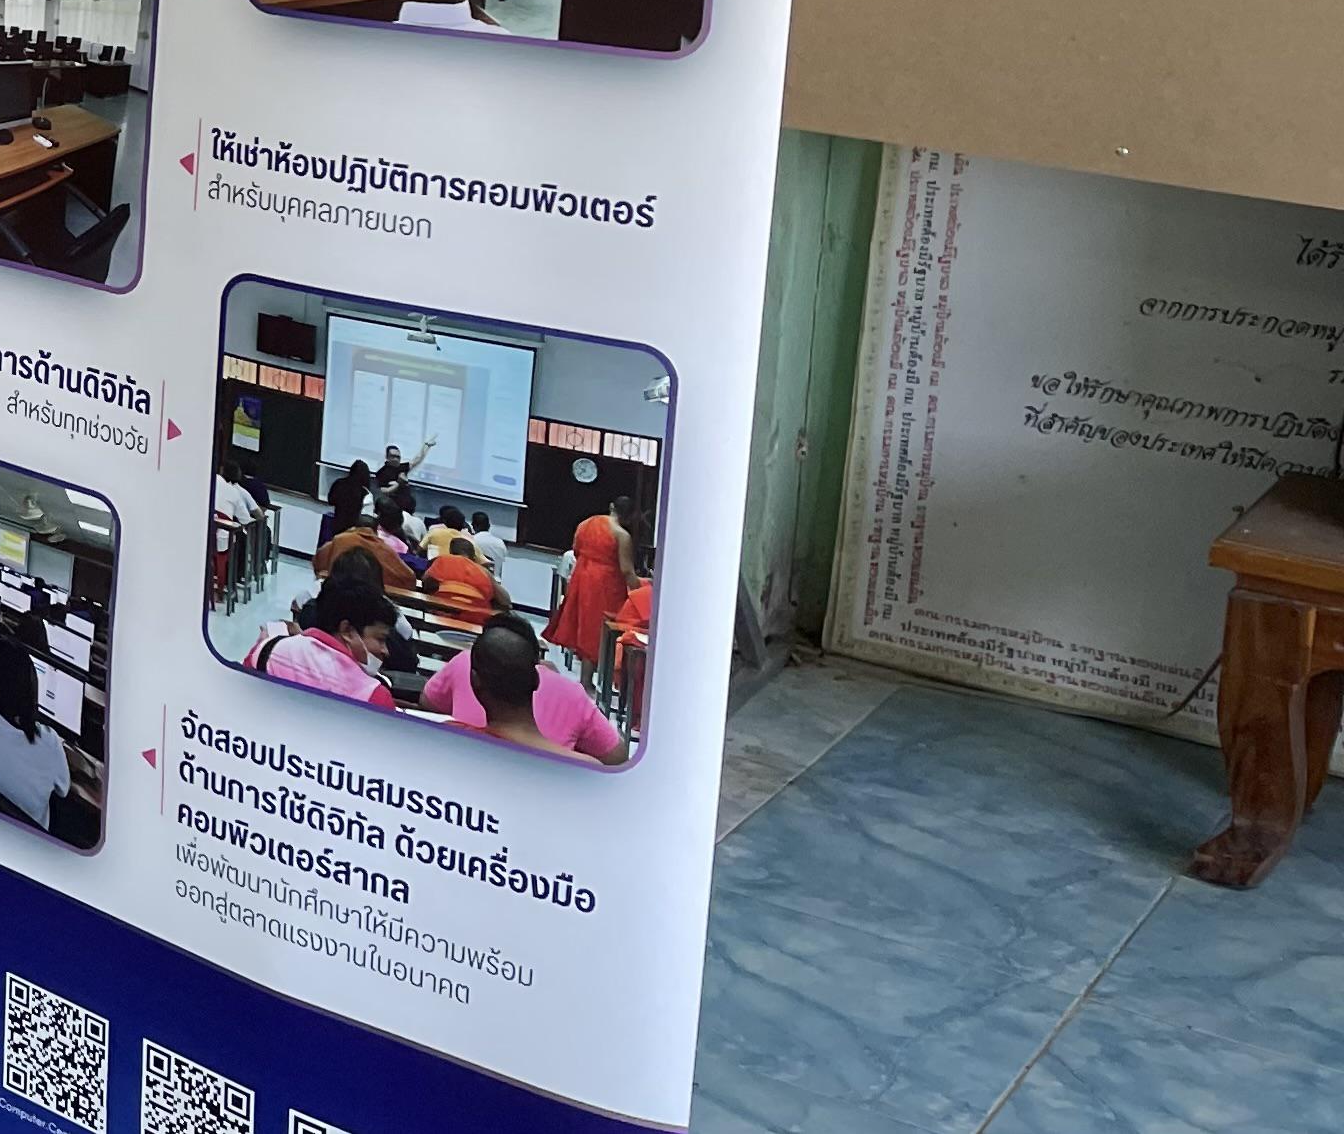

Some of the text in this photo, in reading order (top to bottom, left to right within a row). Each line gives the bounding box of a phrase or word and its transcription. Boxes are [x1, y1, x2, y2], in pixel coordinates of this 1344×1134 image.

[208, 174, 433, 239] สำหรับบุคคลภายนอก
[211, 127, 658, 229] ให้เช่าห้องปฏิบัติการคอมพิวเตอร์
[6, 390, 149, 455] สำหรับทุกช่วงวัย
[180, 709, 500, 835] จัดสอบประเมินสมรรถนะ
[177, 802, 411, 904] คอมพิวเตอร์สากล
[178, 752, 597, 914] ด้านการใช้ดิจิทัล ด้วยเครื่องมือ
[175, 877, 470, 1004] ออกสู่ตลาดแรงงานในอนาคต
[176, 836, 534, 987] เพื่อพัฒนานักศึกษาให้มีความพร้อม
